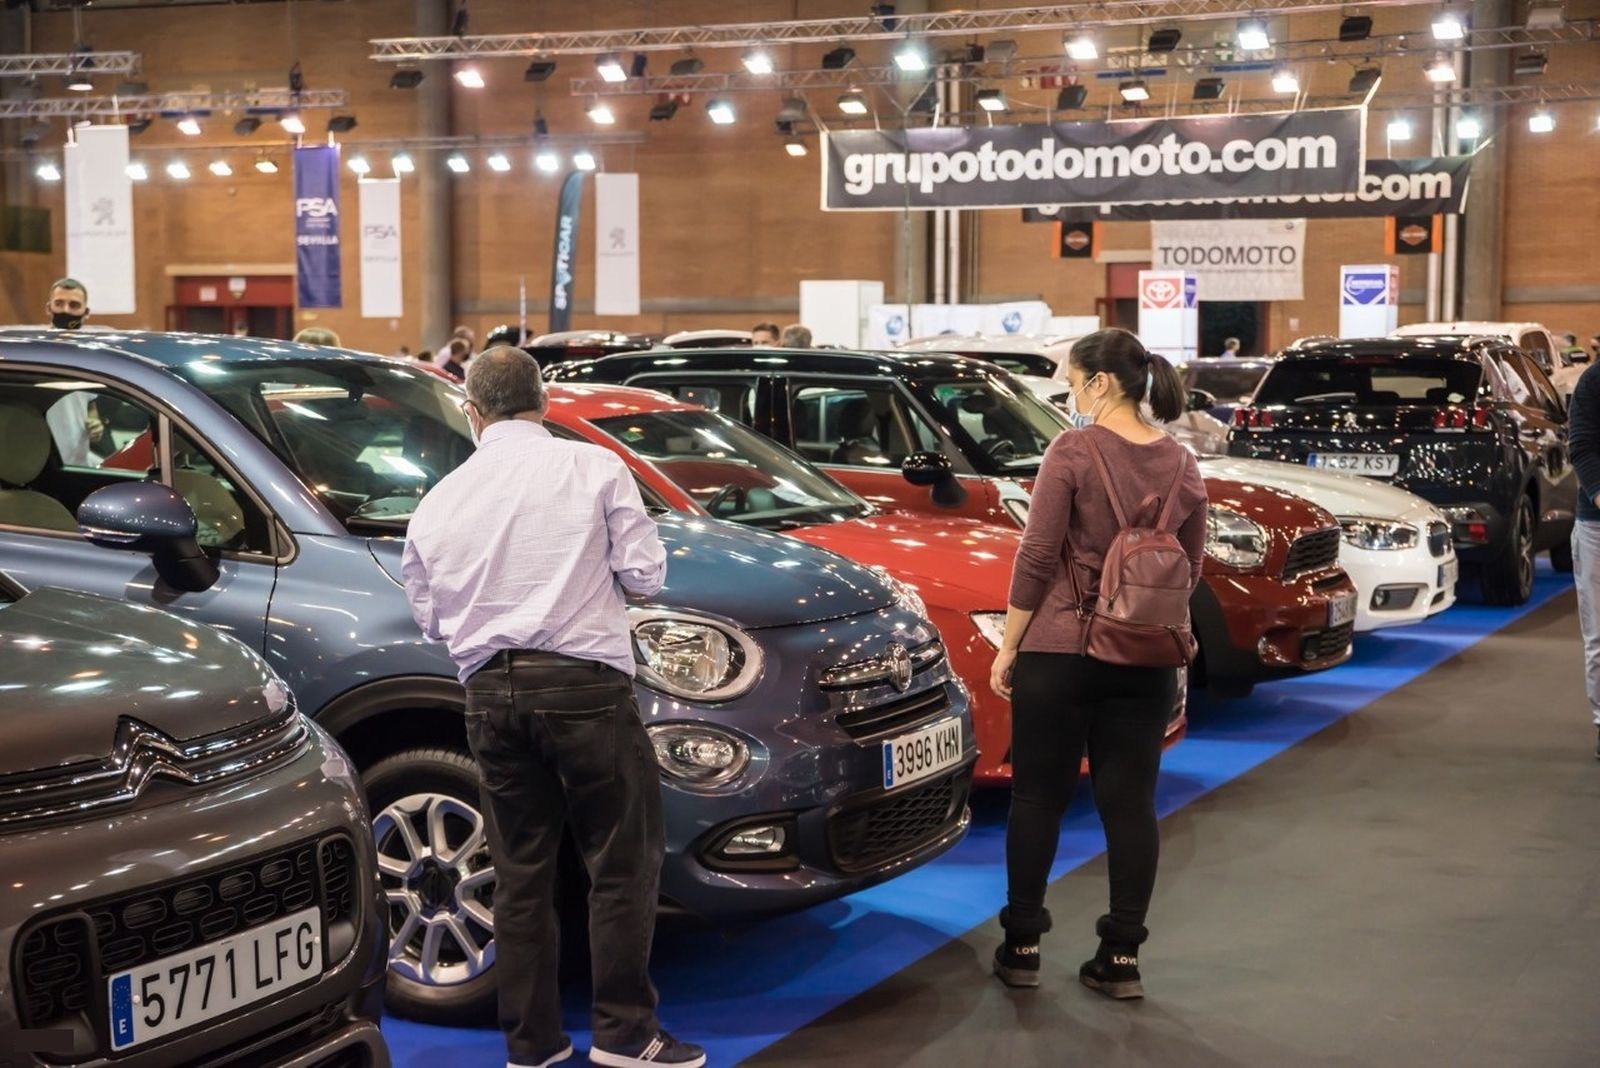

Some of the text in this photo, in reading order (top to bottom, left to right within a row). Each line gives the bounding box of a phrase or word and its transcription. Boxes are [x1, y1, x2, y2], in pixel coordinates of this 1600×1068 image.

[843, 133, 1338, 195] grupotodomoto.com
[297, 198, 338, 217] PSA
[1159, 245, 1297, 266] TODOMOTO
[1363, 455, 1395, 471] KSY
[896, 735, 933, 778] 3996
[935, 724, 959, 765] KHN
[119, 921, 314, 1034] E 5771 LFG
